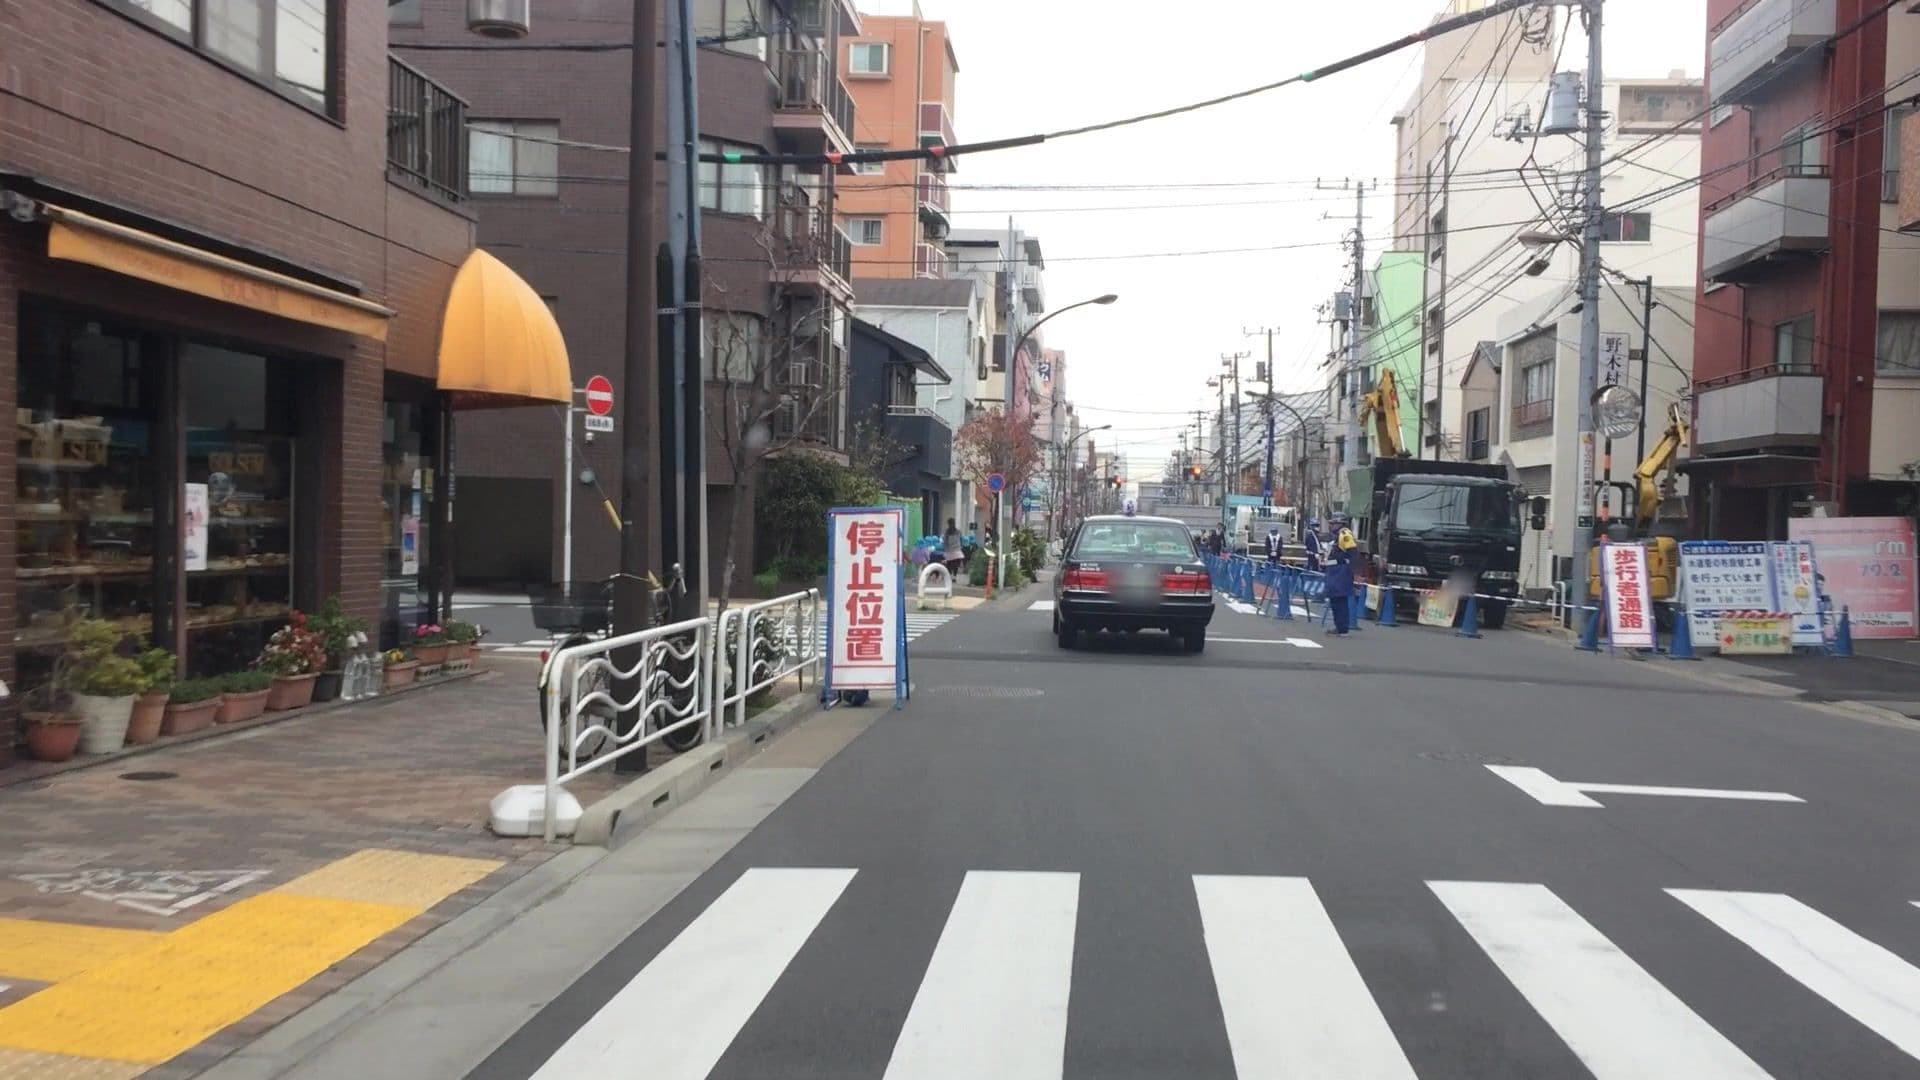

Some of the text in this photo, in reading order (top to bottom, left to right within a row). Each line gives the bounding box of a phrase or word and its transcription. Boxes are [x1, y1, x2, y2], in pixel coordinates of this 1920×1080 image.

[845, 521, 885, 661] 停止位置
[1614, 549, 1643, 629] 歩行者通路
